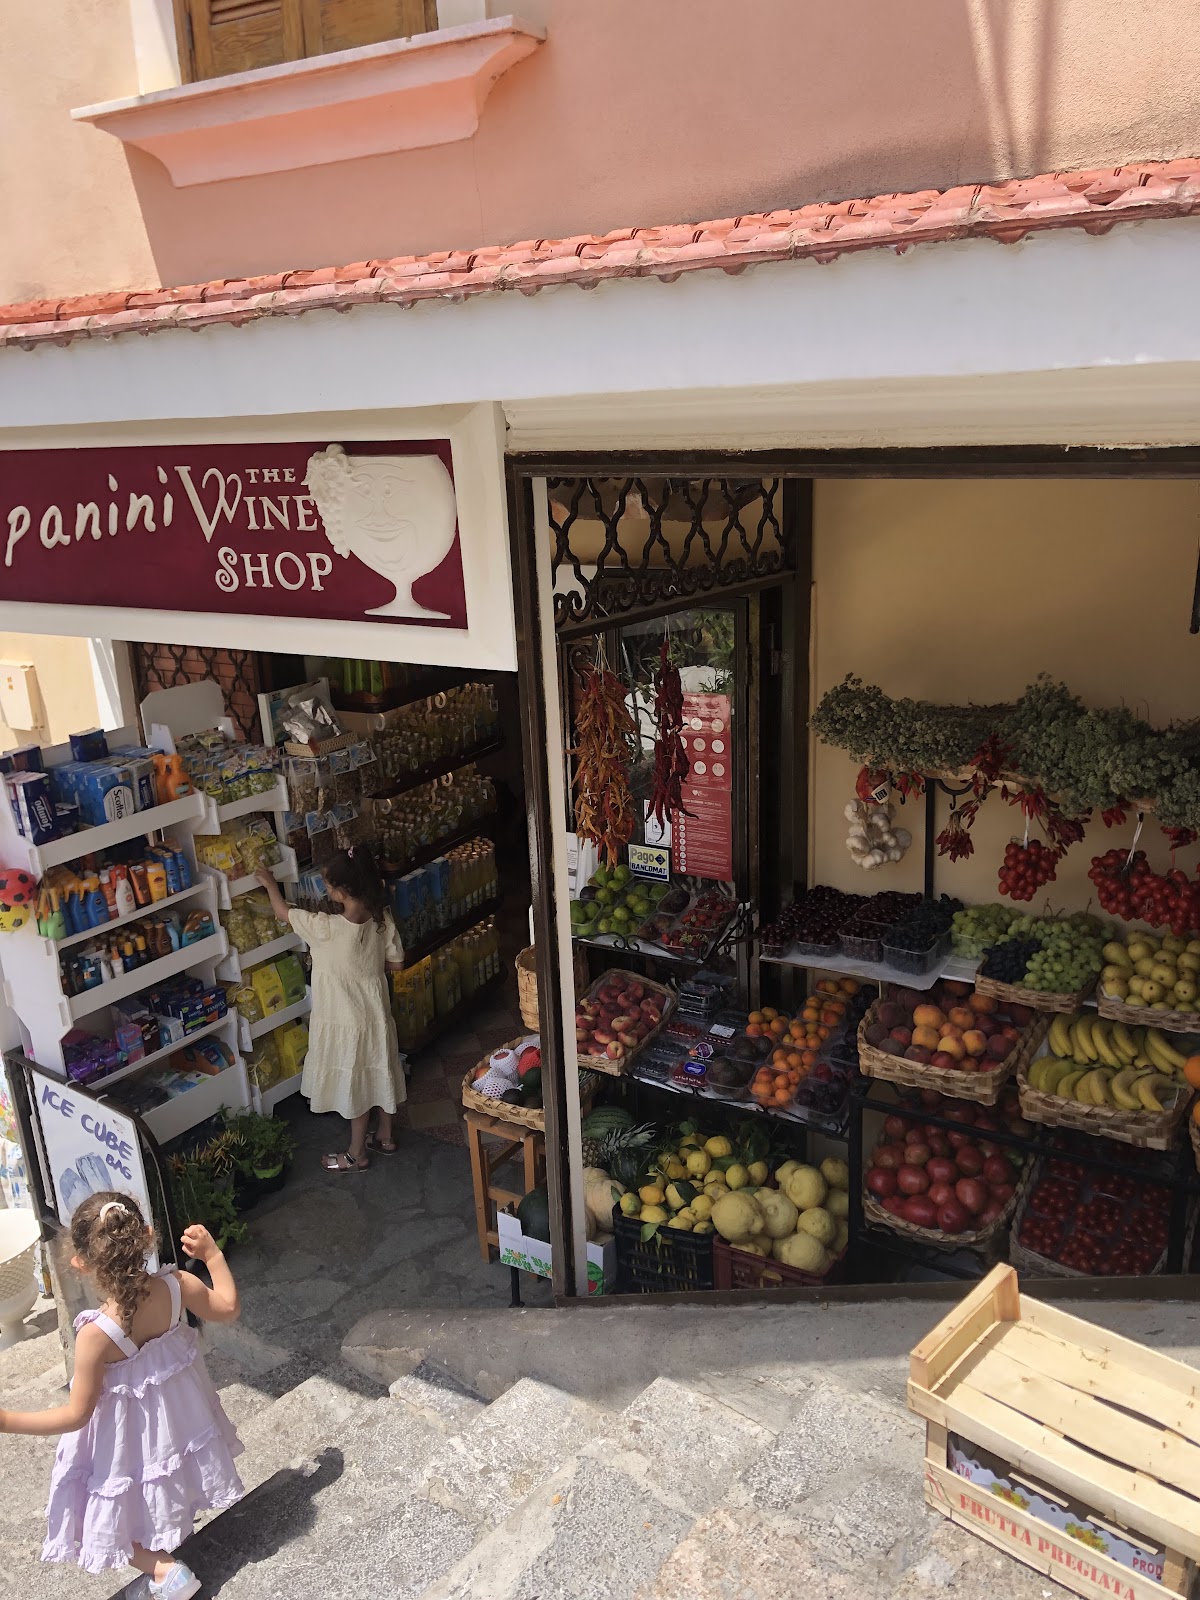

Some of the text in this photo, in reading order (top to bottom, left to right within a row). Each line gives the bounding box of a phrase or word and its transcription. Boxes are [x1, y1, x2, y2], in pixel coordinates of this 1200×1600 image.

[245, 468, 296, 484] THE
[5, 465, 173, 567] panini
[174, 465, 318, 543] WINE
[215, 546, 333, 593] SHOP
[34, 800, 53, 829] Tempo
[630, 848, 655, 864] Pago
[631, 863, 667, 875] BANCOMAT
[42, 1084, 134, 1161] ICE CUBE
[105, 1153, 133, 1181] BAG
[960, 1493, 1136, 1600] FRUTTA PREGIATA
